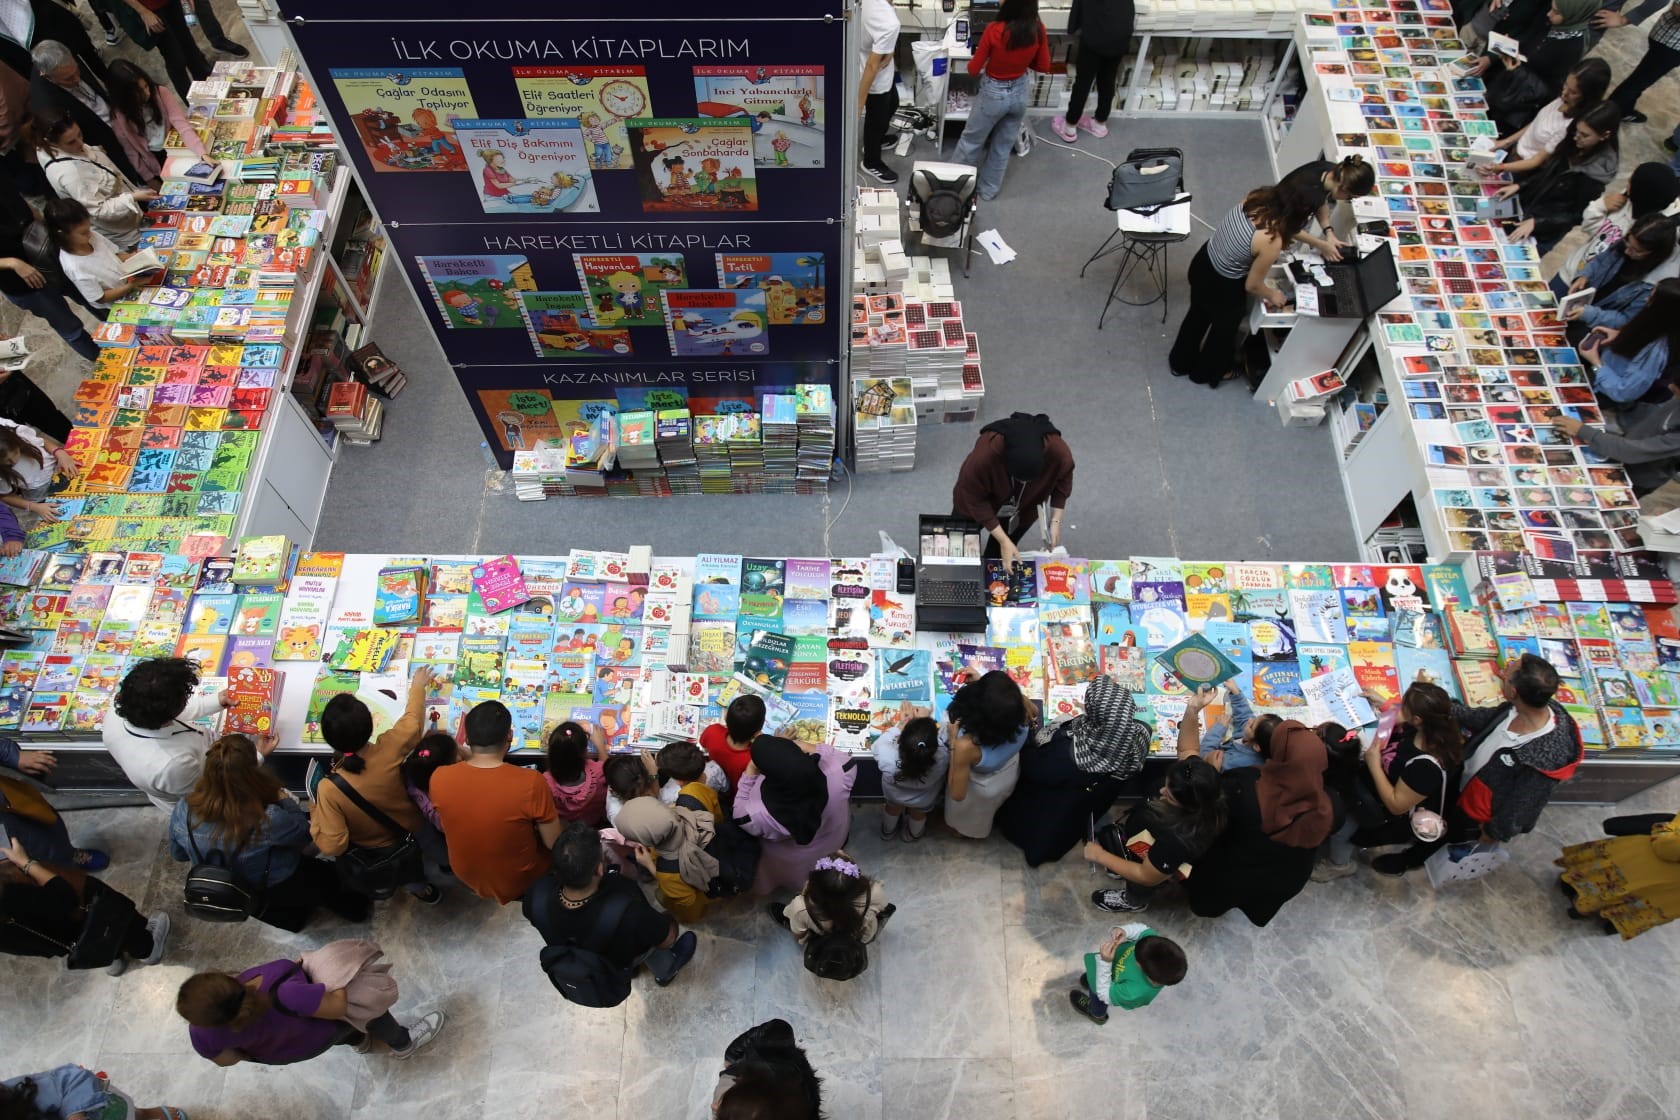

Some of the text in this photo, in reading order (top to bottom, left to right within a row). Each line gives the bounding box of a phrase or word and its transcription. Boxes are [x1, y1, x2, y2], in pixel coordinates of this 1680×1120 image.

[391, 36, 750, 60] İLK OKUMA KİTAPLARIM
[376, 87, 466, 100] Çağlar Odasını
[522, 90, 595, 100] Elif Saatleri
[417, 98, 470, 110] Topluyor
[527, 102, 583, 114] Öğreniyor
[471, 139, 573, 149] Elif Diş Bakımını
[711, 138, 749, 149] Çağlar
[518, 151, 577, 163] Öğreniyor
[682, 149, 749, 158] Sonbaharda
[483, 232, 751, 250] HAREKETLİ KİTAPLAR
[585, 262, 636, 272] Hayvanlar
[728, 262, 755, 272] Tatil
[543, 369, 756, 384] KAZANIMLAR SERİSİ
[746, 563, 769, 571] Uzay
[758, 637, 787, 647] ILDIZLAR
[757, 643, 789, 654] EZEGENLER
[836, 712, 870, 721] TEKNOLOJ
